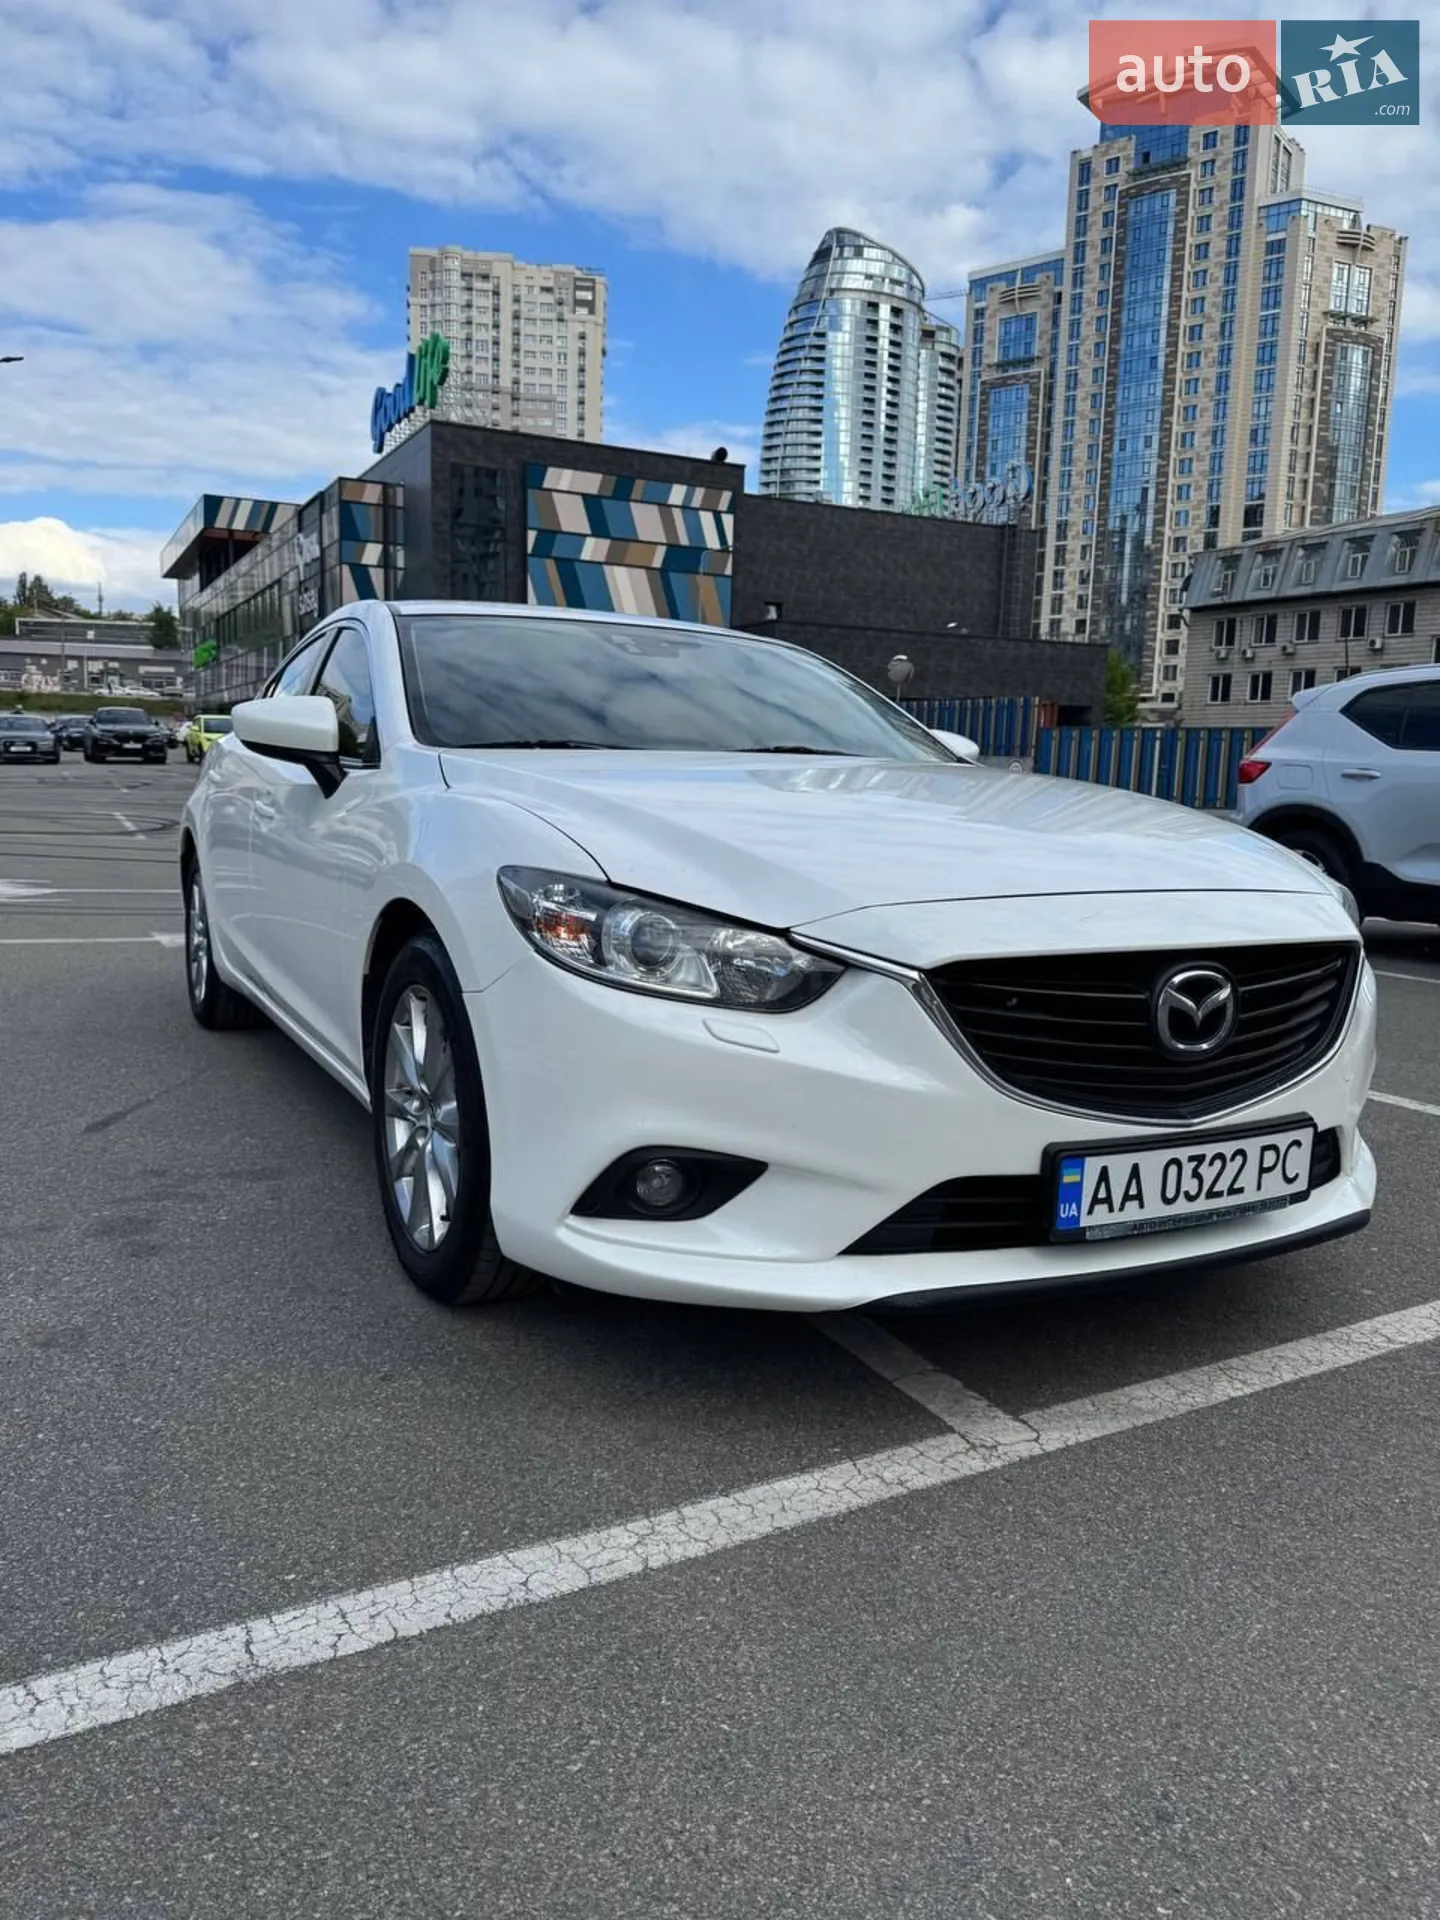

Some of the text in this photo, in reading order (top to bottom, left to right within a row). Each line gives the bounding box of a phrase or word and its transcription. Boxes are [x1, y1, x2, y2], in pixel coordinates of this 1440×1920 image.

[1086, 1162, 1145, 1216] AA
[1160, 1148, 1248, 1206] 0322
[1256, 1139, 1303, 1192] PC
[1059, 1203, 1079, 1219] UA
